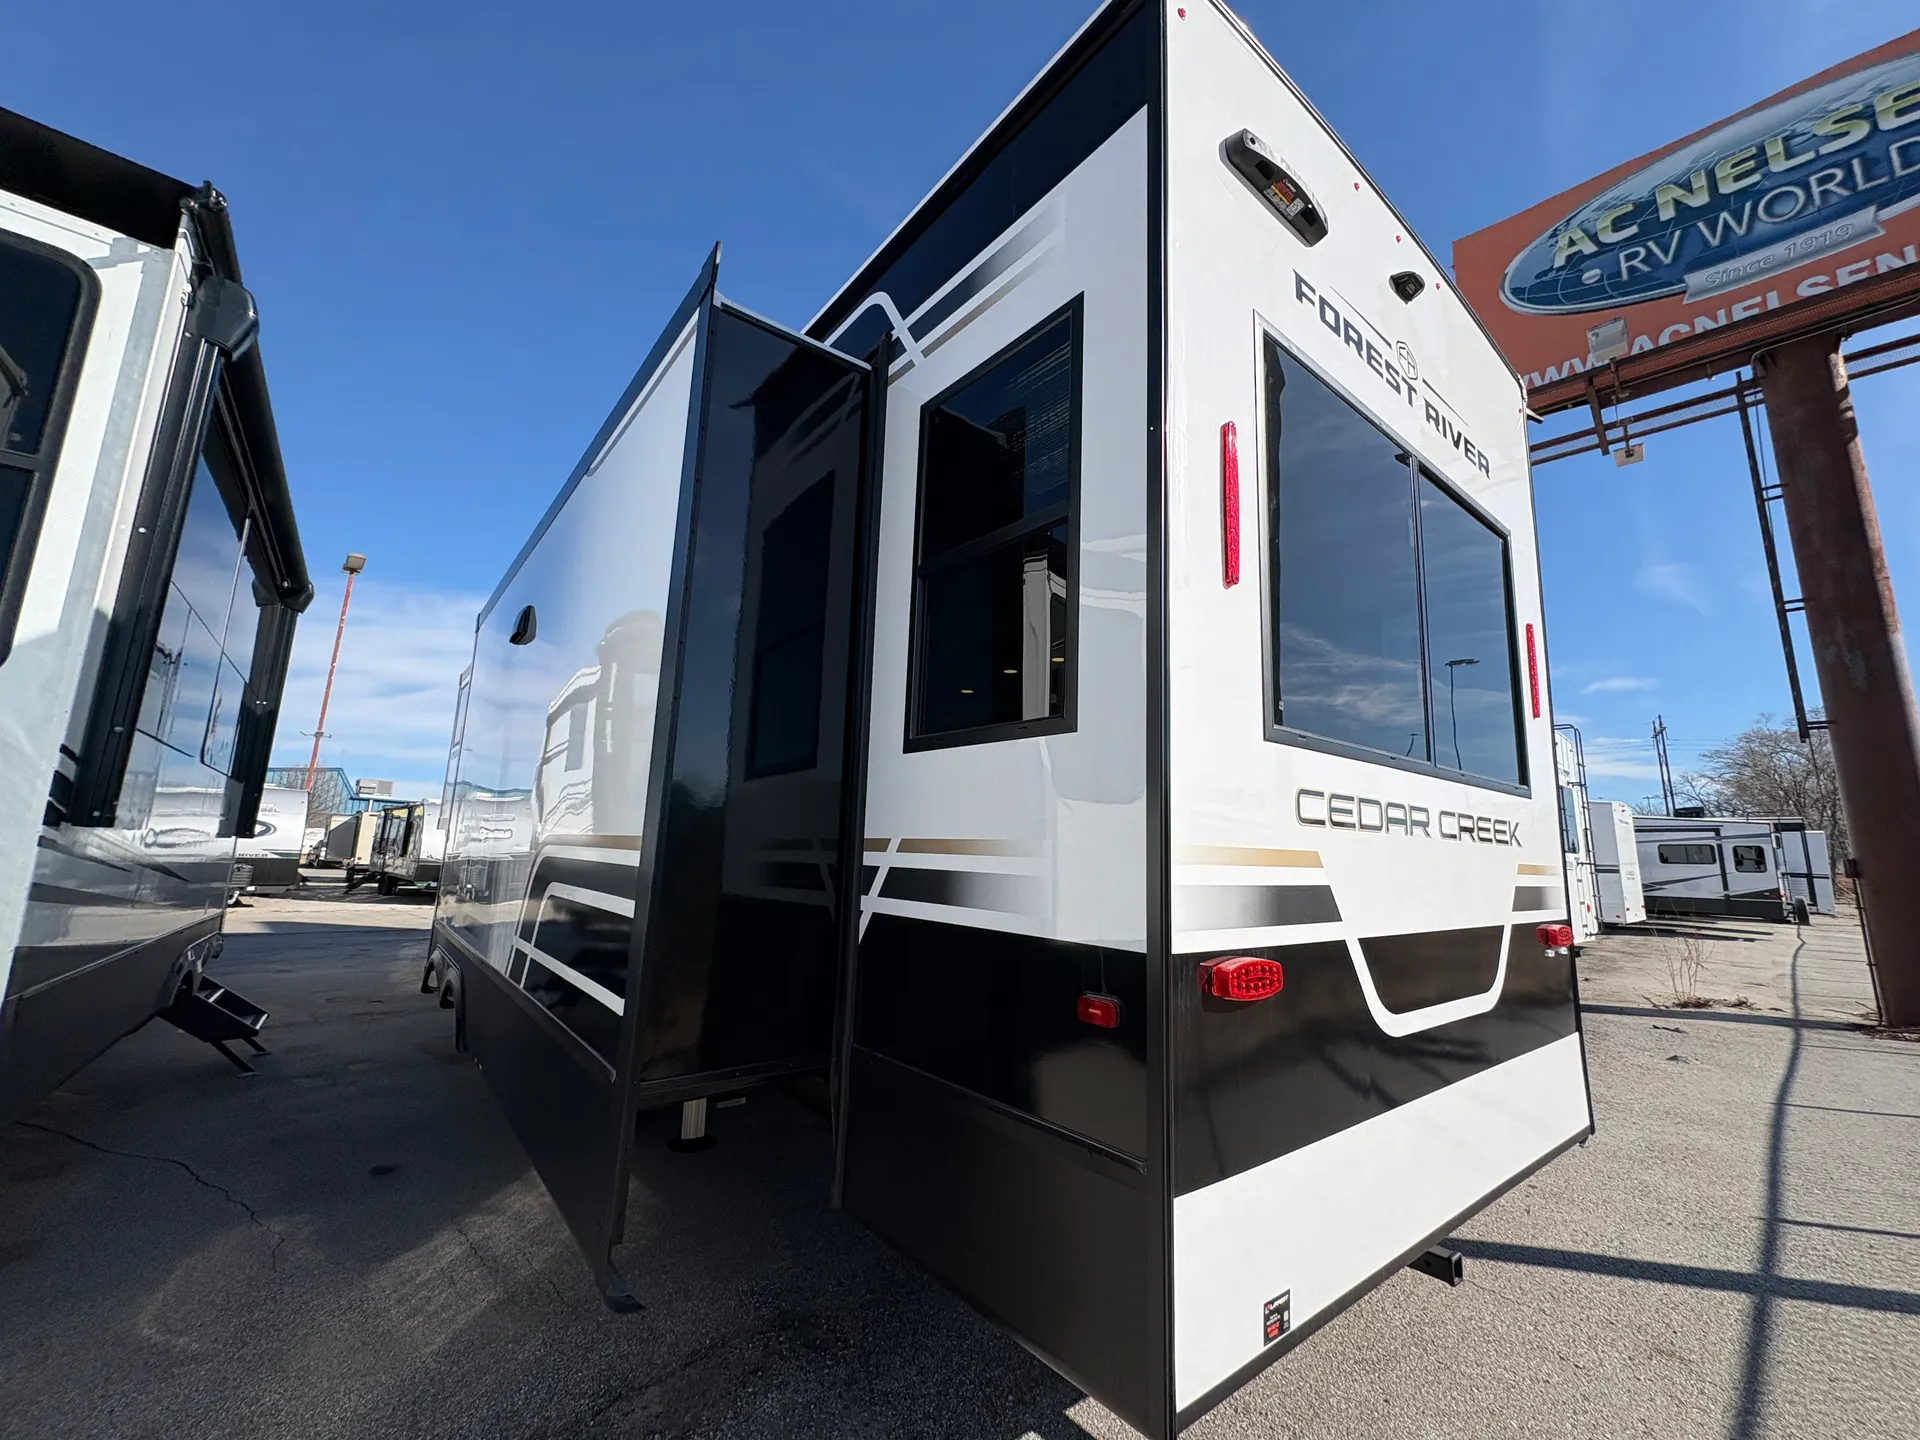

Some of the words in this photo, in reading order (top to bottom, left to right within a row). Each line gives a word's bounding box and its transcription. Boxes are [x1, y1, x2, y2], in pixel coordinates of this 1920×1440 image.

[1553, 203, 1639, 269] AC
[1619, 229, 1682, 281] RV
[1705, 254, 1775, 289] Since
[1784, 223, 1854, 259] 1919
[1292, 268, 1417, 408] FOREST
[1422, 396, 1491, 480] RIVER
[1295, 786, 1432, 839] CEDAR
[1438, 809, 1522, 848] CREEK
